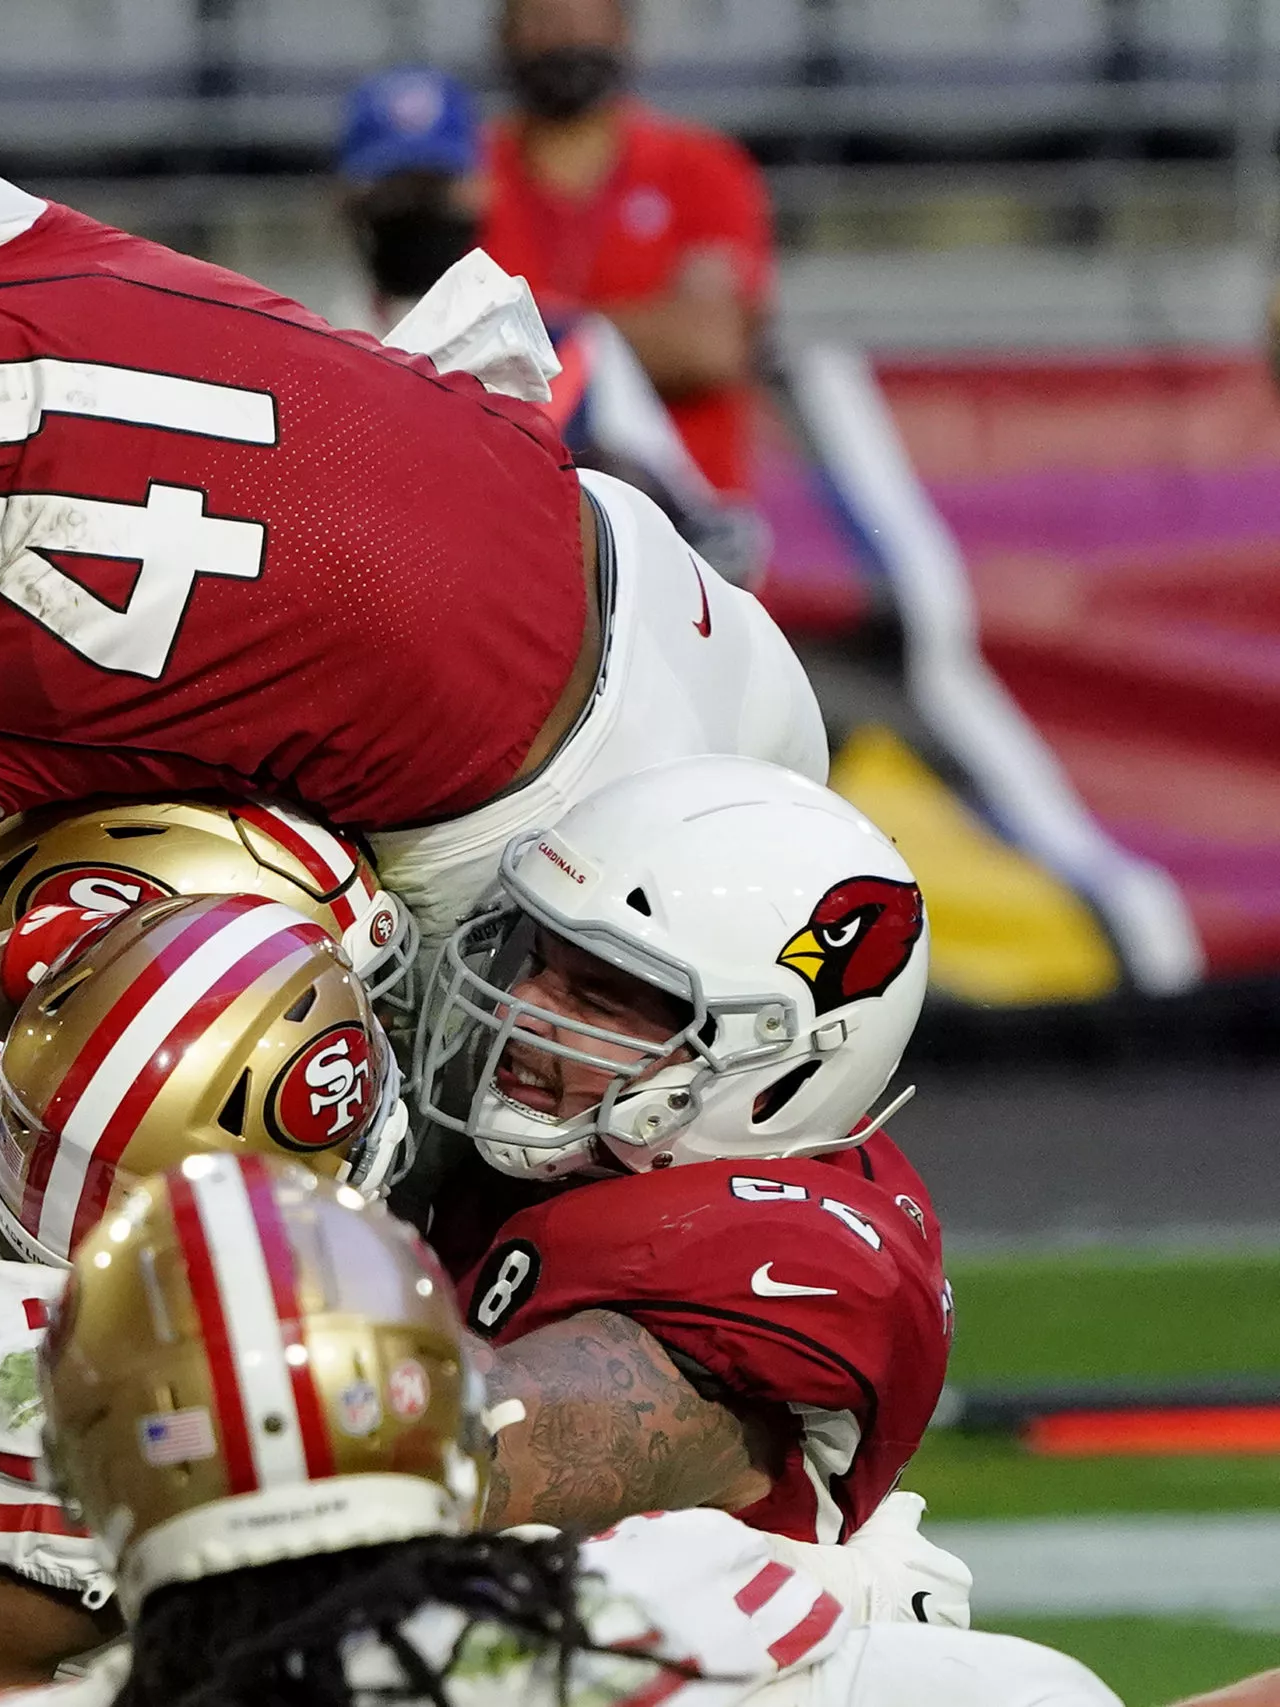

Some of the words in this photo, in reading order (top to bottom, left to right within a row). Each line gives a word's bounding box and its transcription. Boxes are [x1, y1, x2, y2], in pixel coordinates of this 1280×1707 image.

[538, 841, 587, 885] CARDINALS
[305, 1037, 369, 1137] SF
[477, 1249, 531, 1327] 8
